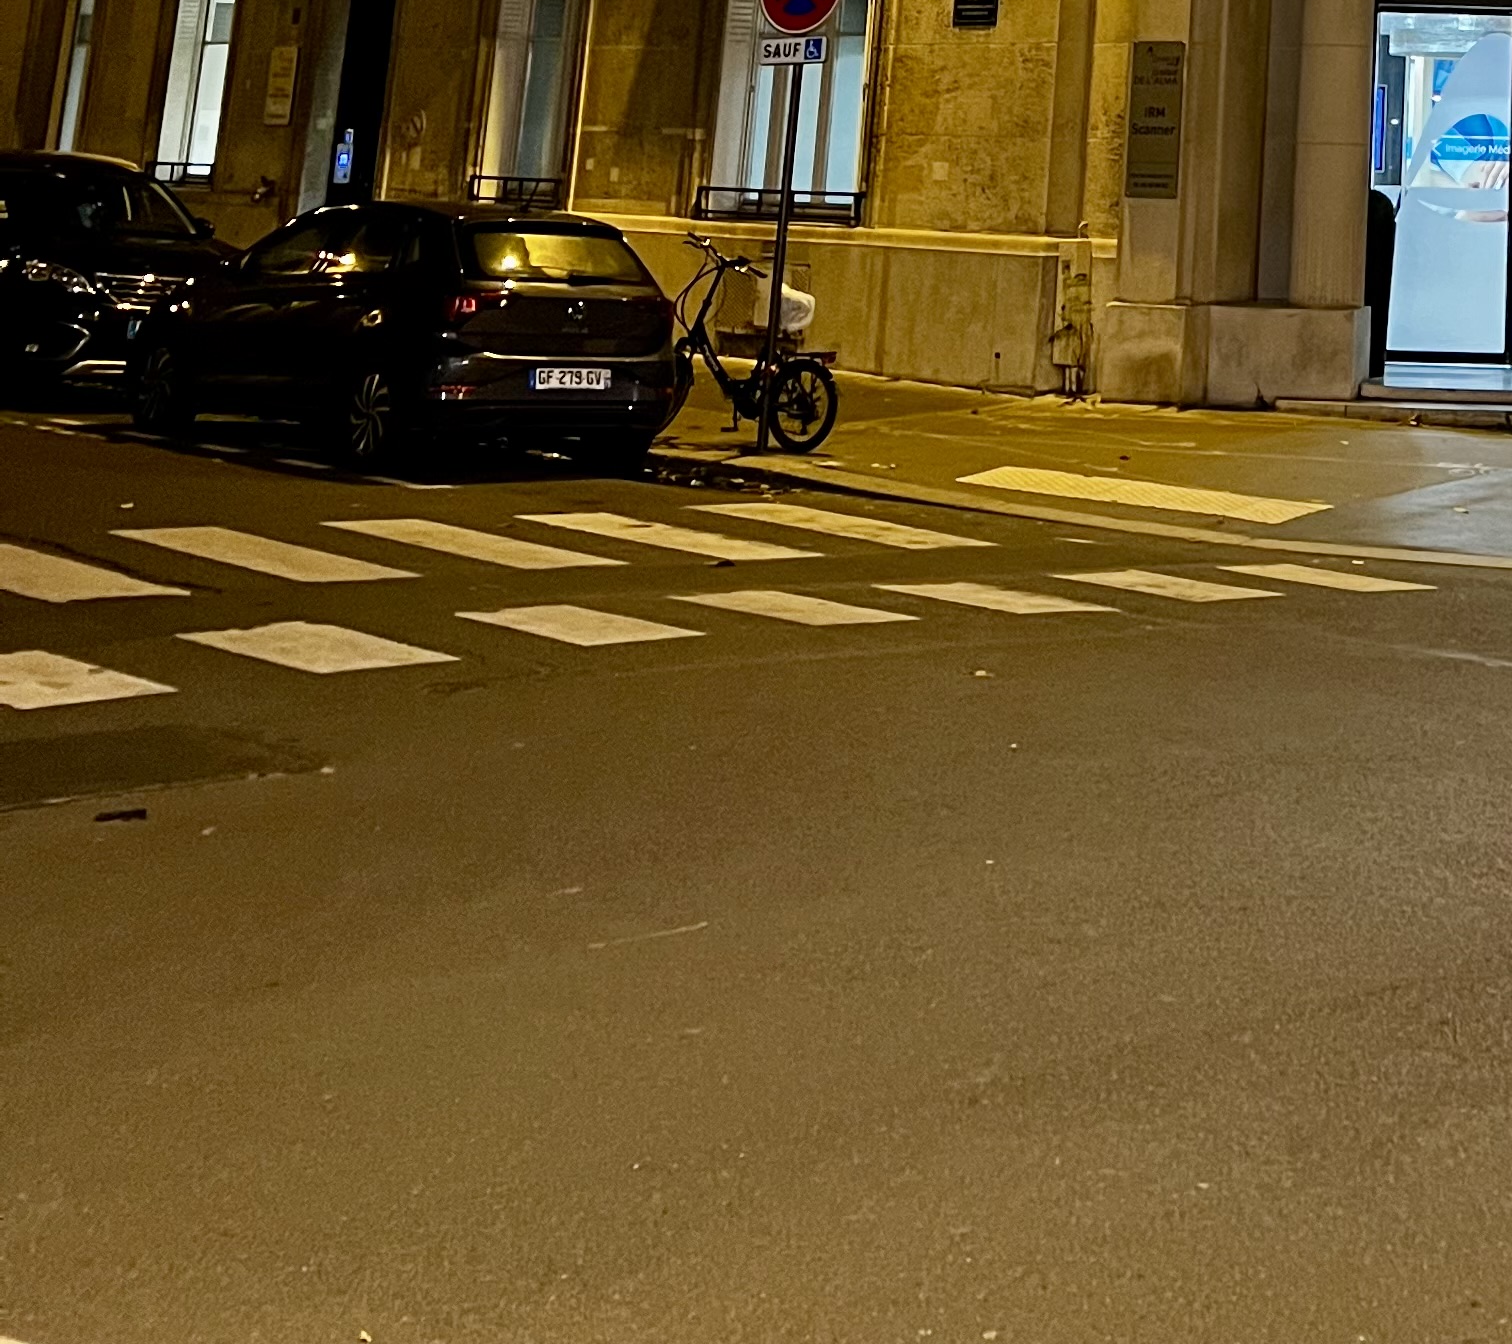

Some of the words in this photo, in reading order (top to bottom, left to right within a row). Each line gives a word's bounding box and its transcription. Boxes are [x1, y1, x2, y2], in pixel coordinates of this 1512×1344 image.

[763, 42, 801, 58] SAUF
[1144, 106, 1166, 118] IRM
[1131, 122, 1175, 135] Scanner
[1445, 144, 1487, 155] Imagerie
